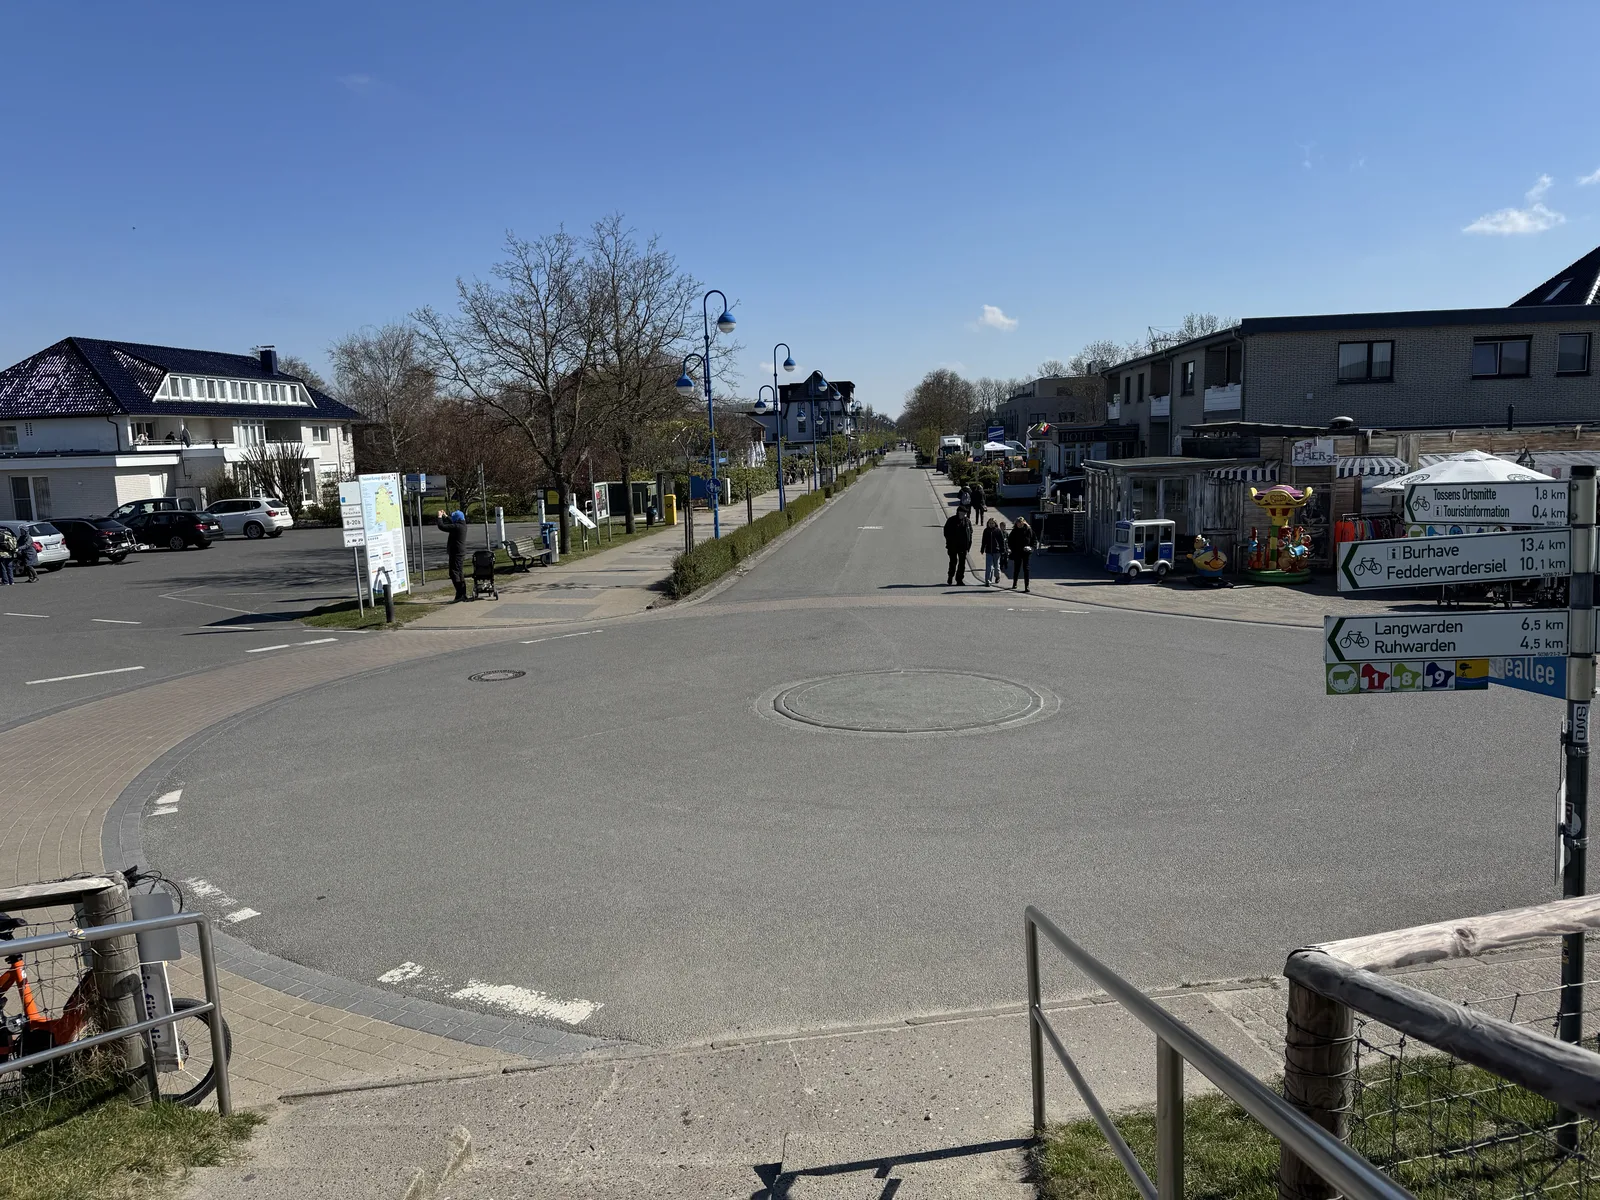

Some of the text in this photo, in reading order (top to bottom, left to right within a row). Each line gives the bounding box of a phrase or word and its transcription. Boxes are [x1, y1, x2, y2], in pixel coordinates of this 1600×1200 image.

[1061, 431, 1095, 441] HOTEL
[1433, 486, 1566, 501] Tossens Ortsmitte 1,8 km
[1444, 505, 1510, 518] Touristinformation
[1532, 505, 1547, 519] 0,4
[1551, 507, 1565, 518] km
[1402, 544, 1460, 560] Burhave
[1520, 538, 1545, 552] 13,4
[1549, 538, 1566, 550] km
[1387, 556, 1566, 580] Fedderwardersiel 10,1 km
[1374, 617, 1564, 638] Langwarden 6,5 km
[1374, 636, 1564, 654] Ruhwarden 4,5 km
[1371, 673, 1379, 687] 1
[1401, 672, 1413, 686] 8
[1434, 671, 1445, 685] 9
